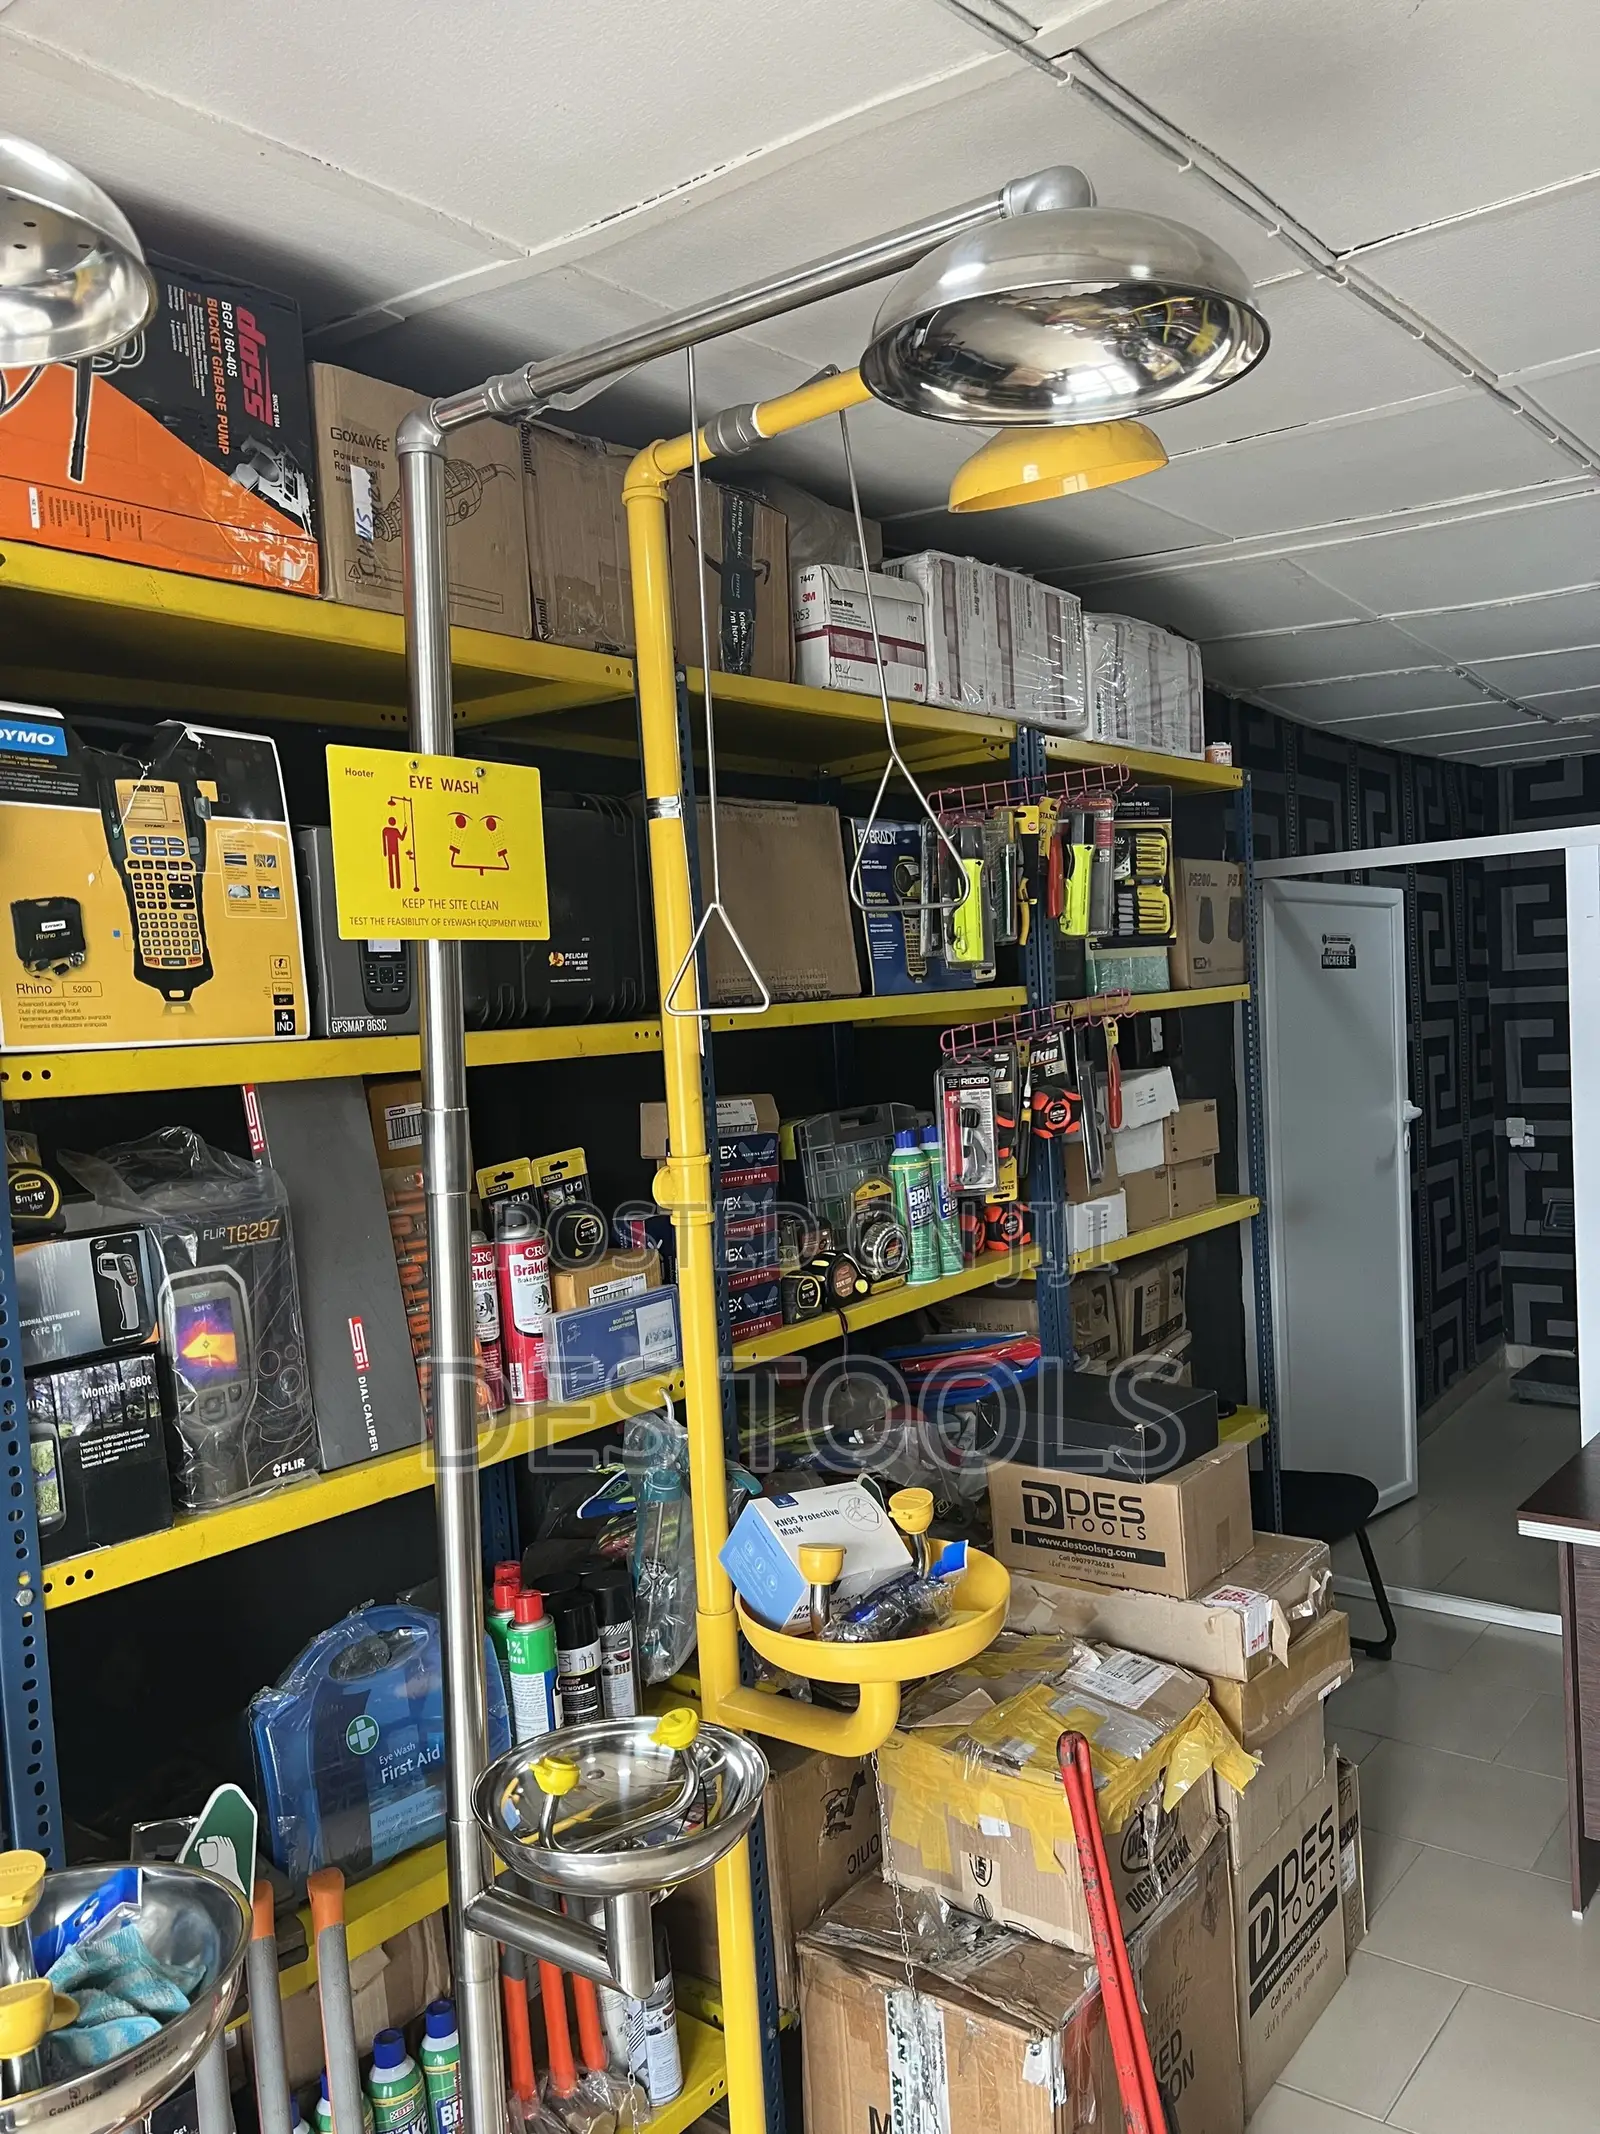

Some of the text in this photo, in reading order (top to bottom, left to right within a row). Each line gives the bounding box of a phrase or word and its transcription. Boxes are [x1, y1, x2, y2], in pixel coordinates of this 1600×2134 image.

[222, 301, 233, 329] BGP
[225, 338, 238, 378] 60-405
[206, 297, 230, 455] BUCKET GREASE PUMP
[330, 427, 388, 452] GOXAWEE
[334, 450, 361, 464] Power
[363, 456, 386, 470] Tools
[800, 574, 815, 584] 7447
[802, 592, 816, 603] 3M
[914, 682, 923, 692] 3M
[344, 767, 375, 779] Hooter
[409, 775, 480, 795] EYE WASH
[869, 829, 897, 845] BRADY
[402, 898, 500, 911] KEEP THE SITE CLEAN
[350, 916, 543, 929] TEST THE FEASIBILITY OF EYEWASH EQUIPMENT WEEKLY
[36, 932, 56, 941] Rhino
[565, 952, 589, 960] PELICAN
[1322, 956, 1351, 966] INCREASE
[16, 983, 93, 995] Rhino 5200
[276, 1021, 294, 1032] IND
[332, 1020, 365, 1033] GPSMAP
[1030, 1048, 1059, 1064] fkin
[960, 1076, 990, 1085] RIDGID
[16, 1181, 40, 1189] STANLEY
[542, 1174, 562, 1183] STANLEY
[725, 1172, 767, 1183] SAFETY EYEWEAR
[909, 1186, 932, 1207] BRA
[204, 1227, 226, 1241] FLIR
[227, 1219, 280, 1244] TG297
[749, 1272, 770, 1281] EYEWEAR
[43, 1310, 81, 1324] INSTRUMENTS
[732, 1321, 772, 1336] SAFETY EYEWEAR
[994, 1323, 1014, 1332] JOINT
[82, 1375, 152, 1400] Montana 680t
[358, 1376, 379, 1452] DIAL CALIPER
[282, 1458, 306, 1474] FLIR
[1065, 1488, 1146, 1525] DES
[774, 1508, 840, 1528] KN95 Protective
[780, 1526, 804, 1537] Mask
[1067, 1516, 1147, 1541] TOOLS
[1038, 1536, 1137, 1560] www.destoolsng.com
[1058, 1554, 1115, 1570] Call 09079736285
[792, 1612, 811, 1621] Mas
[510, 1657, 526, 1665] FREE
[379, 1742, 416, 1766] Eye Wash
[381, 1744, 441, 1784] First Aid
[847, 1832, 881, 1875] onic
[1282, 1804, 1335, 1911] DES
[1282, 1855, 1336, 1939] TOOLS
[1265, 1909, 1325, 1989] www.destoolsng.com
[1270, 1990, 1282, 2011] Call
